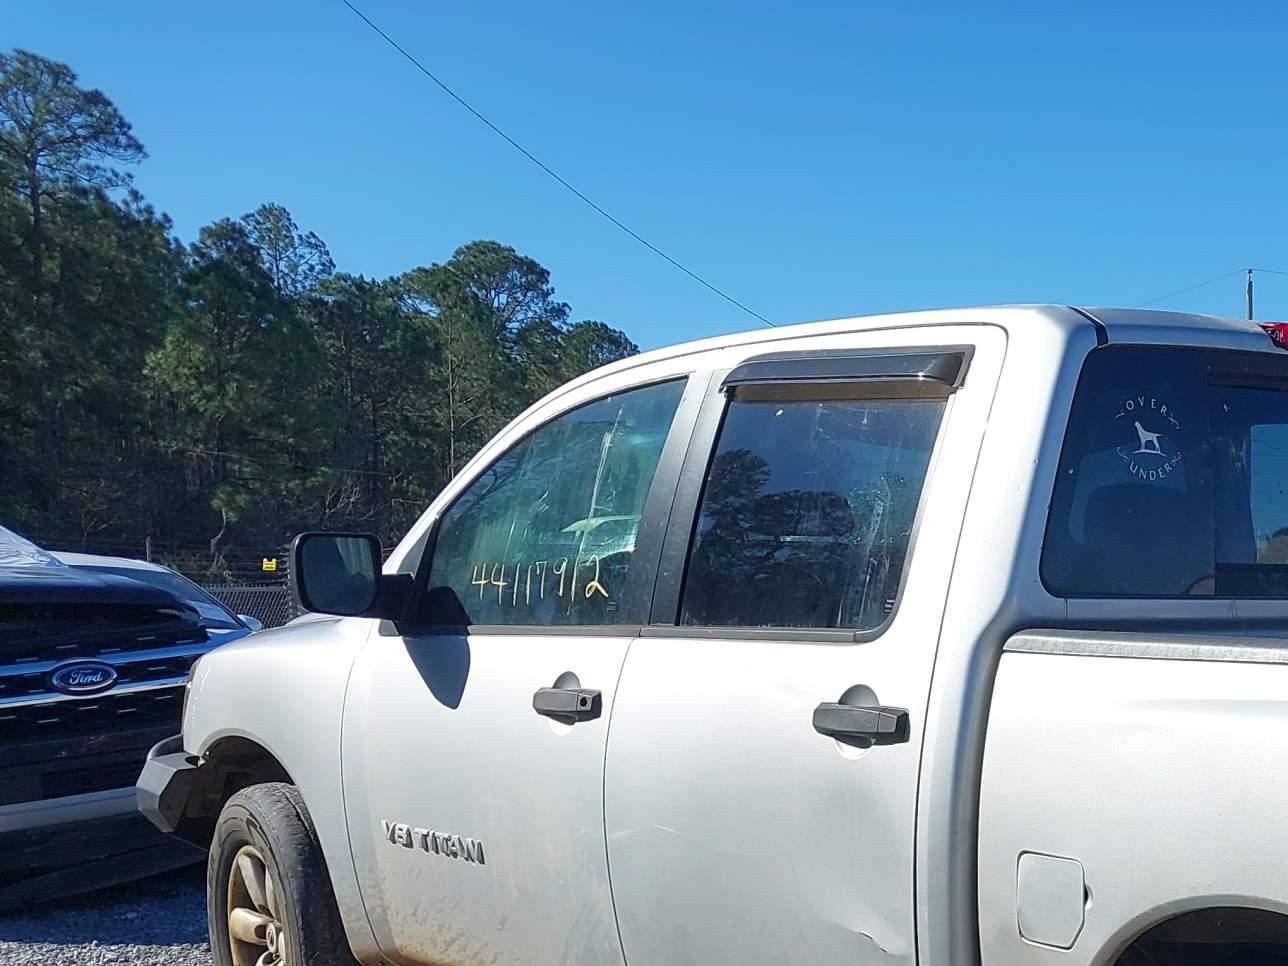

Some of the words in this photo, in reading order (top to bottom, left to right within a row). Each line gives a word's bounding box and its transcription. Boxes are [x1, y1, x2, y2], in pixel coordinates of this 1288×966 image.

[1125, 396, 1168, 417] OVER
[1129, 460, 1173, 481] UNDER
[471, 554, 609, 606] 44117912
[380, 819, 414, 849] V8
[414, 827, 486, 865] TITAN
